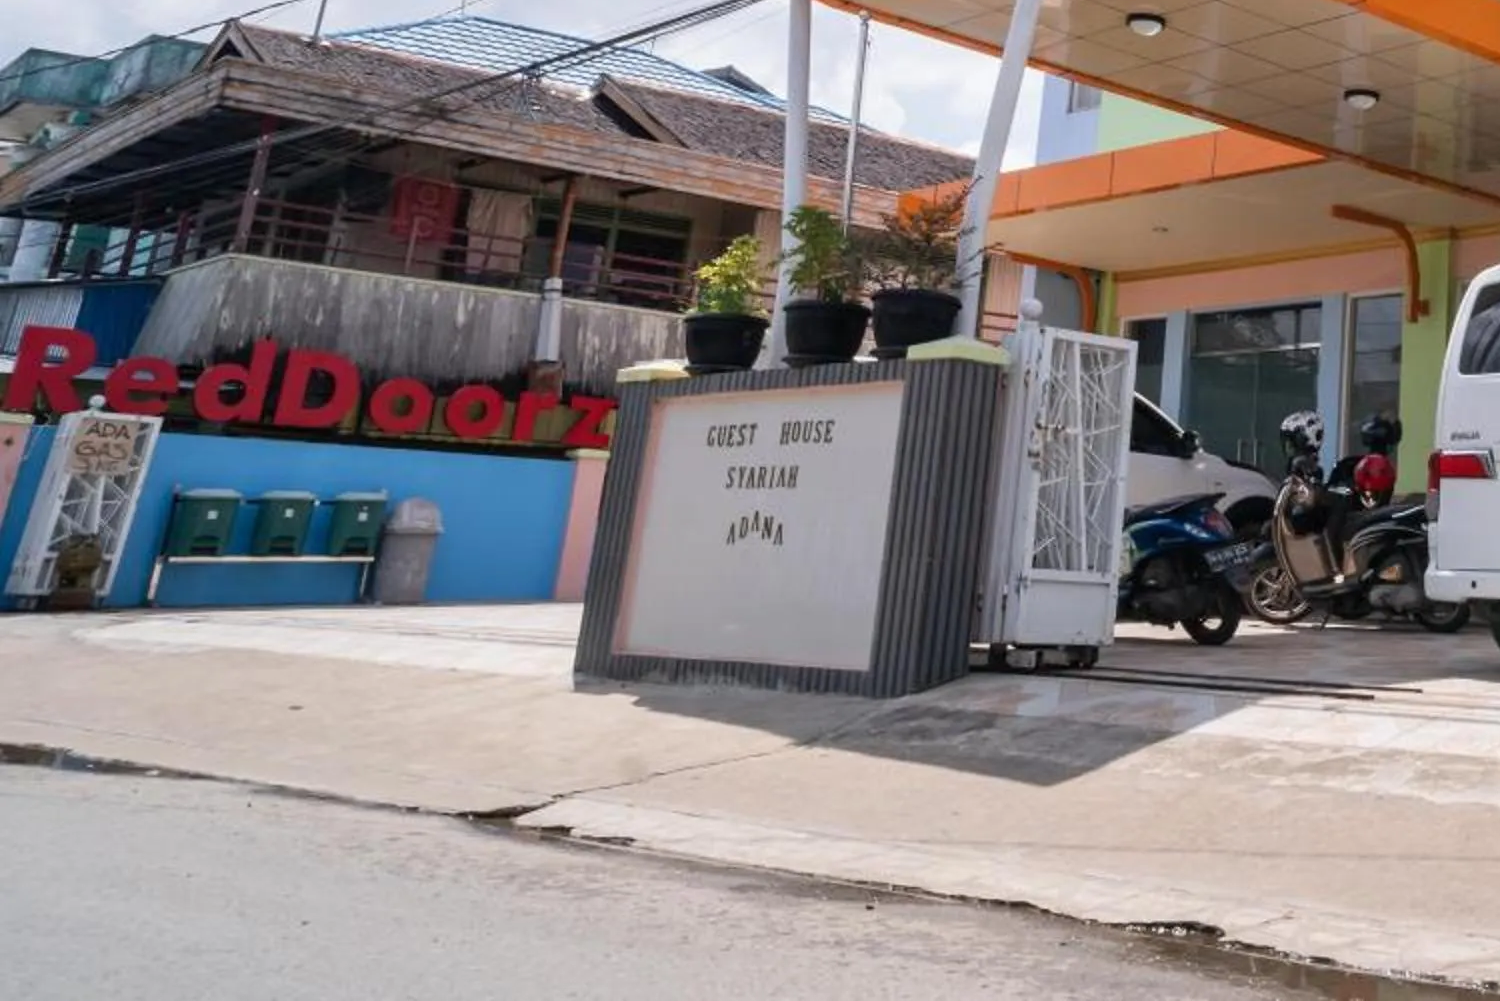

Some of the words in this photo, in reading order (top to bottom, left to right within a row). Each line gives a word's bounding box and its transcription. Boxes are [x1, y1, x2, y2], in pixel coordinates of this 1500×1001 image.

[3, 324, 620, 449] RedDoorz
[84, 420, 131, 440] ADA
[706, 422, 758, 448] GUEST
[779, 419, 836, 446] HOUSE
[725, 464, 799, 490] SYARIAH
[726, 509, 784, 546] ADANA
